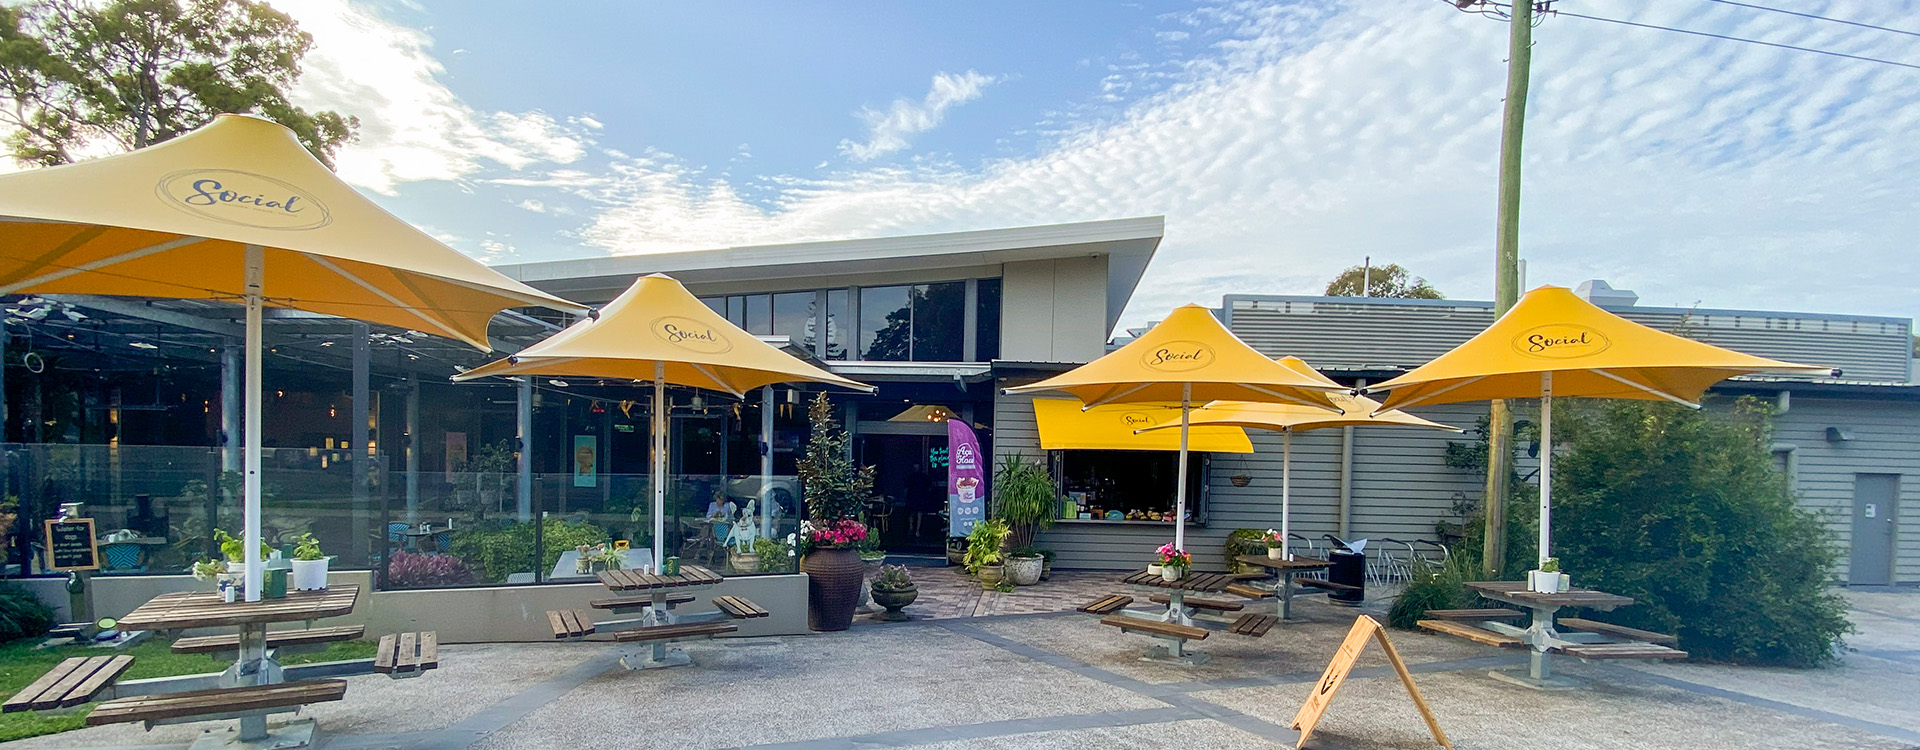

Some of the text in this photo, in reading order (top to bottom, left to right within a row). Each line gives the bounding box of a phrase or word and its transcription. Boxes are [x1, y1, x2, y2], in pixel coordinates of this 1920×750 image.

[185, 179, 305, 213] Social
[664, 324, 717, 343] Social
[1527, 332, 1593, 353] Social
[1150, 348, 1204, 366] Social
[1125, 415, 1150, 425] Social
